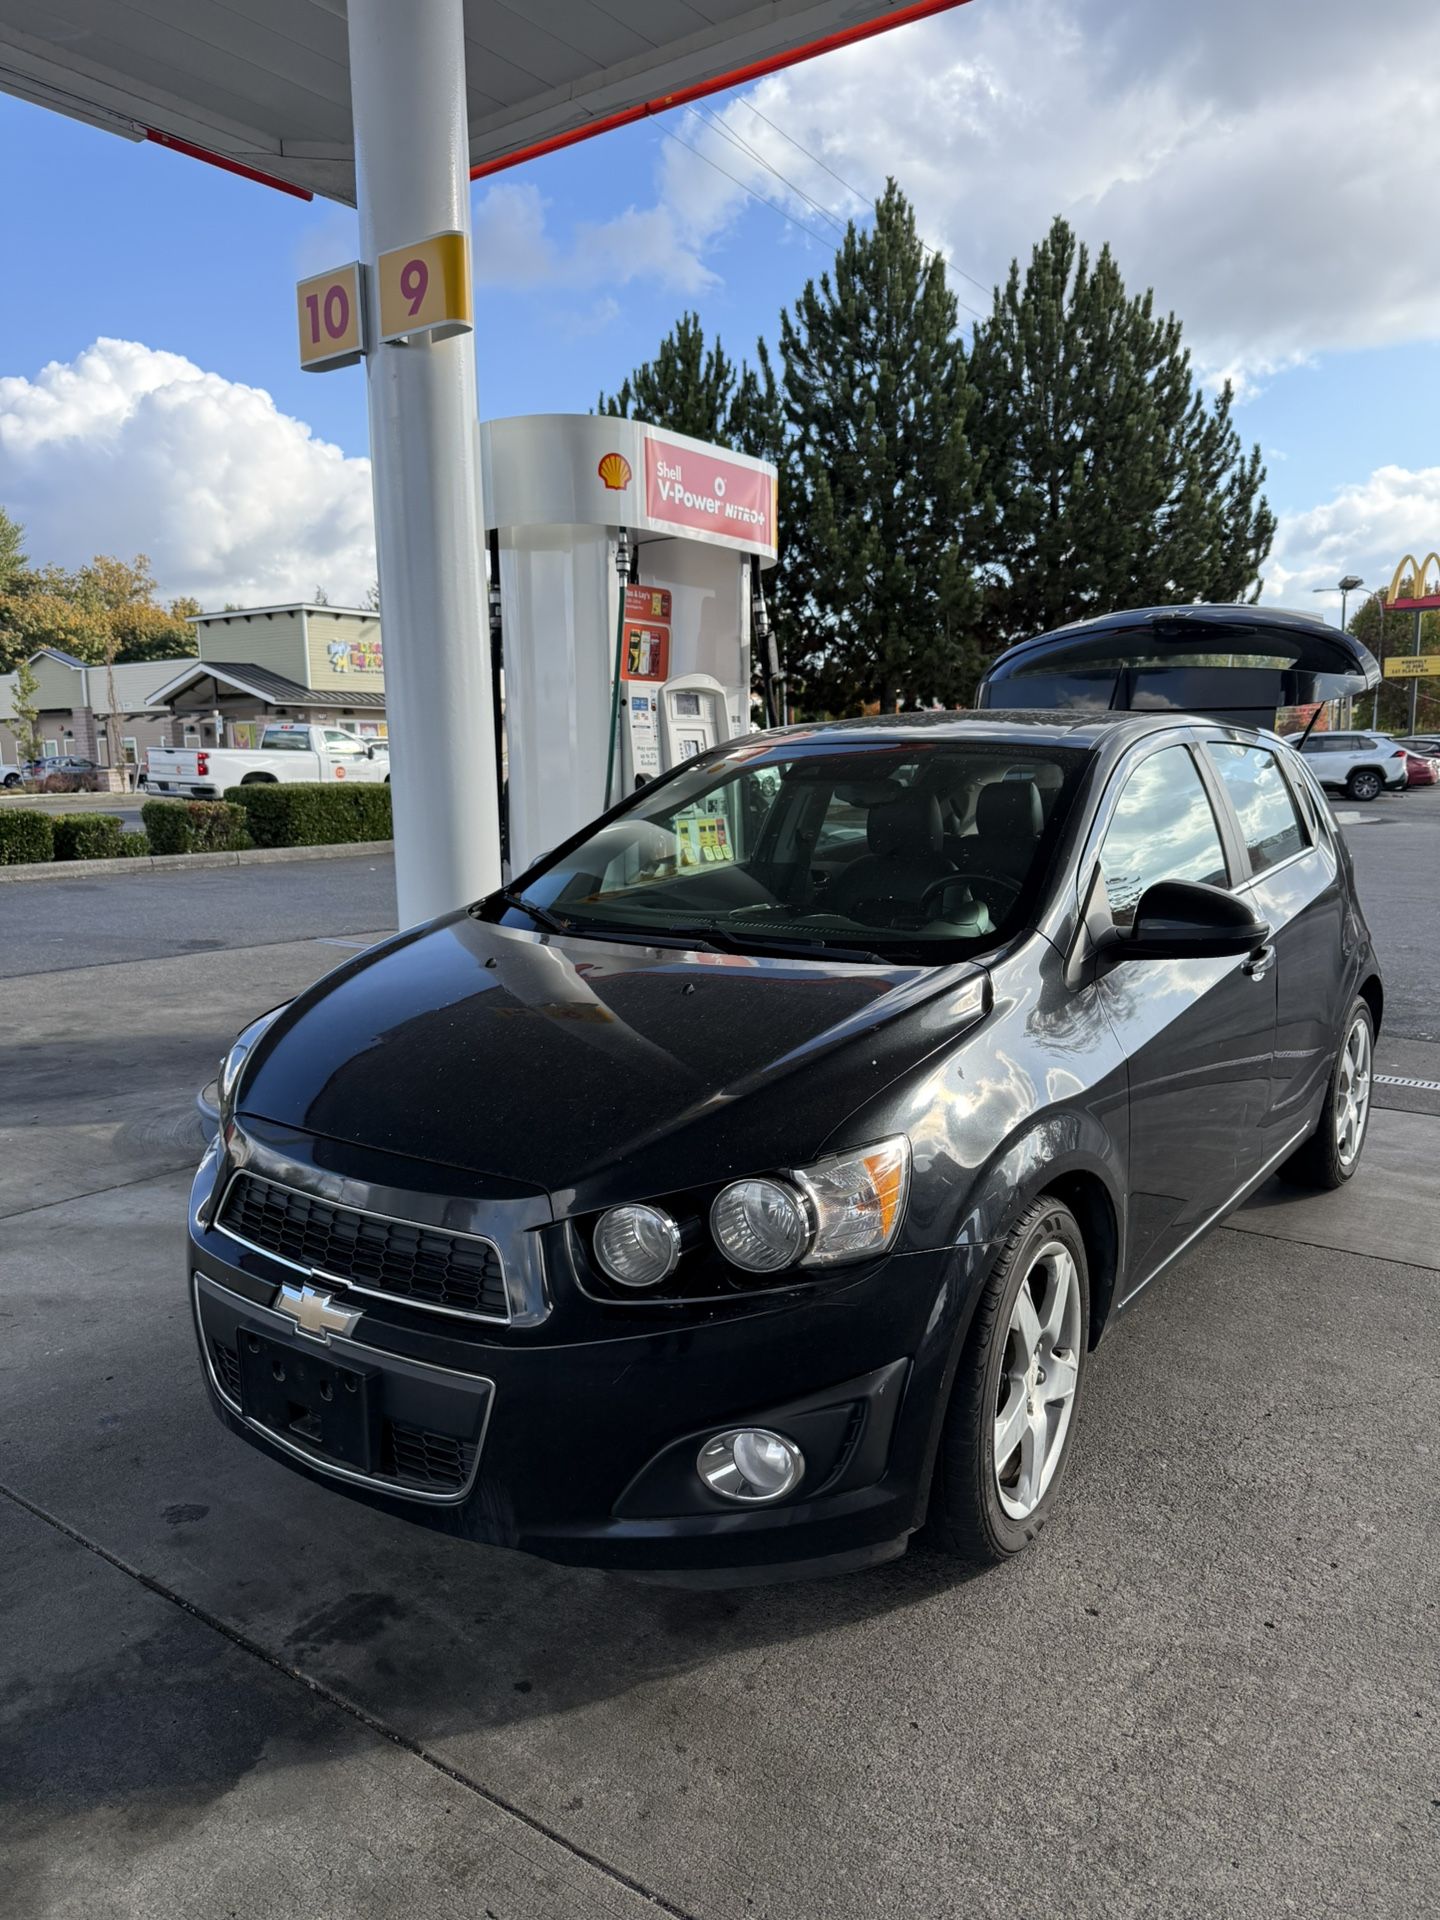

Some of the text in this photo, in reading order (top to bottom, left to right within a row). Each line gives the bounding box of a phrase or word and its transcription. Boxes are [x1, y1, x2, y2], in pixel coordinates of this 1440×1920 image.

[400, 259, 429, 317] 9
[306, 284, 350, 344] 10
[657, 461, 682, 482] Shell
[657, 478, 721, 514] V-Power
